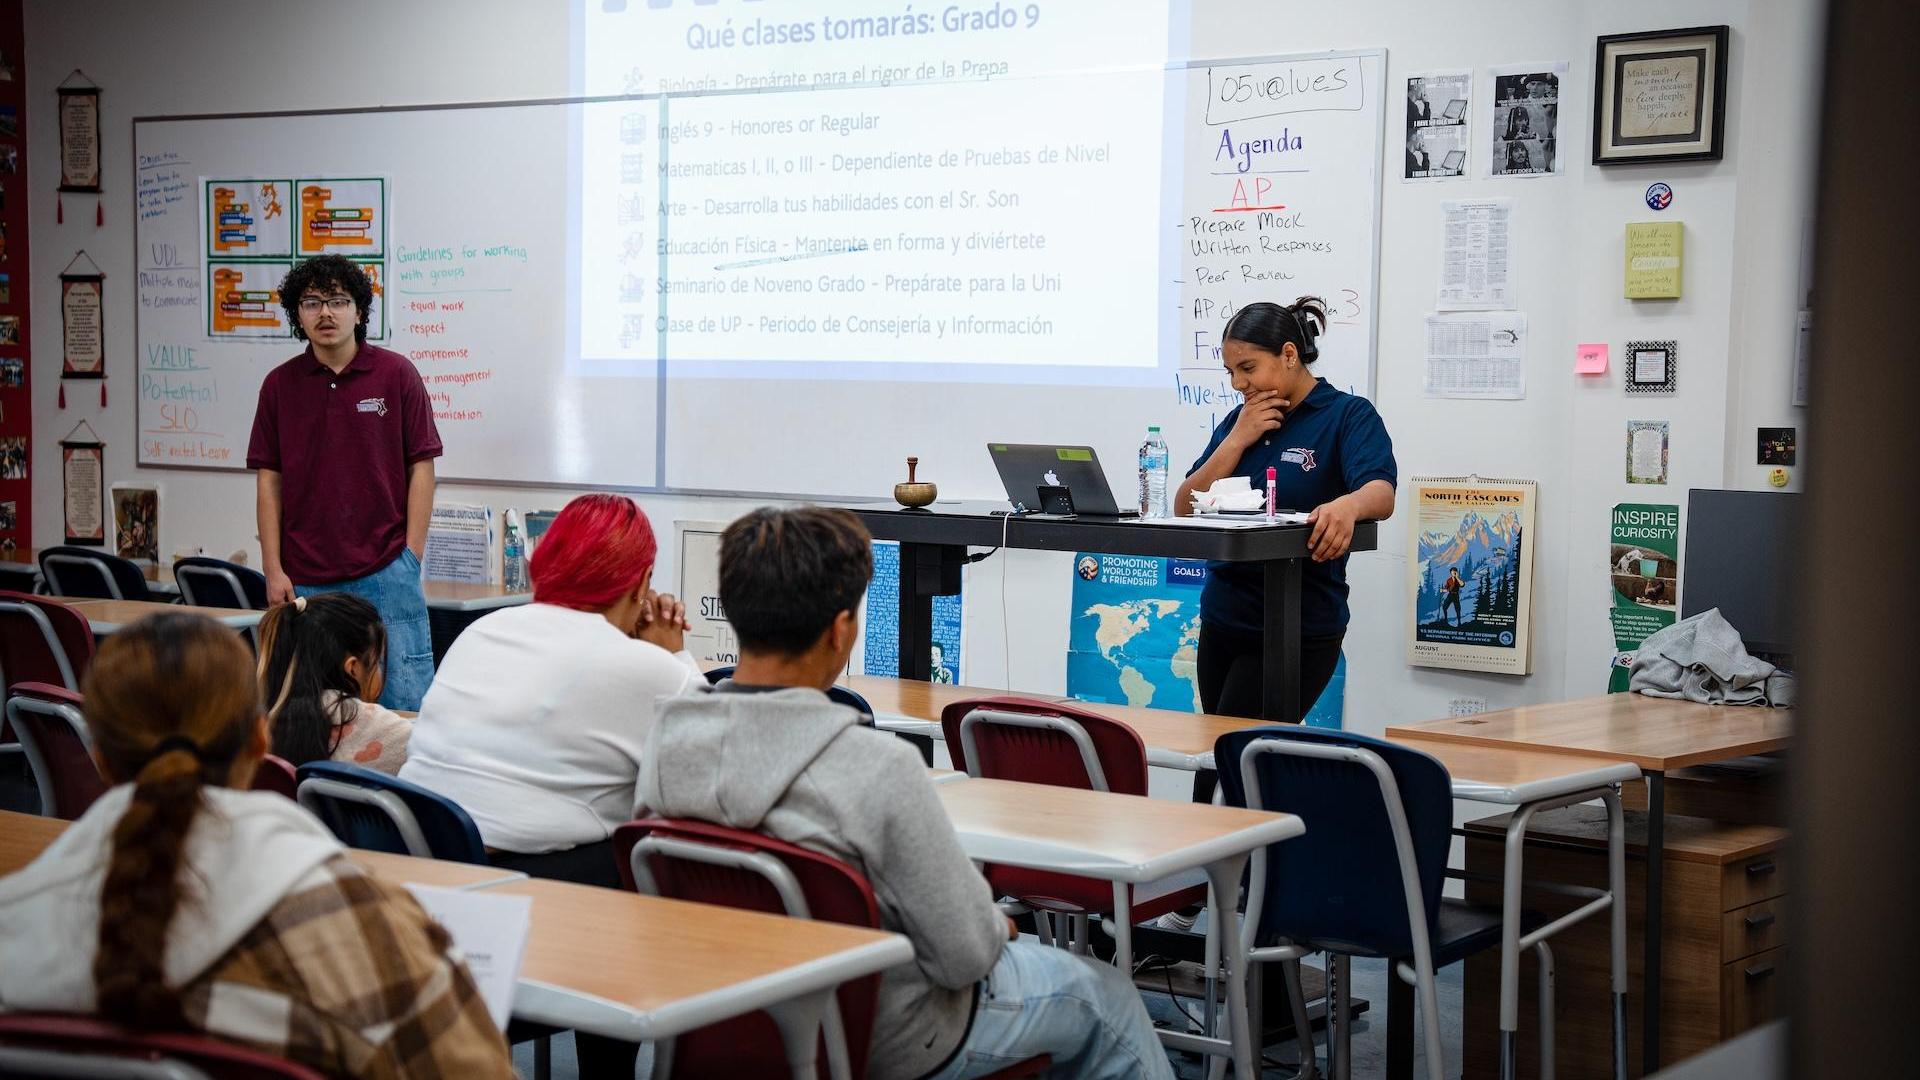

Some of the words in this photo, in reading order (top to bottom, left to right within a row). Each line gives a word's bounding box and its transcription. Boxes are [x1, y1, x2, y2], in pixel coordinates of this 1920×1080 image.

[686, 18, 735, 50] Qué
[742, 16, 815, 47] clases
[823, 4, 935, 42] tomarás:
[942, 2, 1018, 34] Grado
[1024, 4, 1040, 28] 9
[813, 70, 847, 91] para
[852, 65, 866, 82] el
[871, 65, 908, 87] rigor
[915, 60, 936, 79] de
[942, 59, 955, 79] la
[962, 60, 1009, 81] Prepa
[657, 121, 699, 144] Inglés
[703, 121, 713, 137] 9
[731, 119, 793, 136] Honores
[798, 118, 816, 134] or
[820, 112, 881, 137] Regular
[784, 160, 795, 174] o
[831, 150, 933, 176] Dependiente
[938, 149, 958, 167] de
[964, 147, 1031, 167] Pruebas
[1037, 144, 1058, 164] de
[1064, 142, 1111, 162] Nivel
[1215, 127, 1303, 174] Agenda
[657, 199, 687, 216] Arte
[704, 196, 779, 216] Desarrolla
[784, 198, 807, 213] tus
[813, 192, 898, 213] habilidades
[904, 195, 934, 210] con
[939, 189, 953, 209] el
[959, 190, 980, 209] Sr.
[987, 189, 1020, 208] Son
[1231, 177, 1272, 207] AP
[1191, 216, 1247, 237] Prepare
[657, 234, 729, 256] Educación
[735, 234, 777, 254] Física
[795, 235, 869, 253] Mantente
[873, 236, 892, 251] en
[897, 232, 945, 251] forma
[951, 236, 961, 256] y
[965, 229, 1046, 250] diviértete
[1191, 239, 1251, 257] Written
[1259, 235, 1333, 254] Responses
[151, 243, 184, 267] UDL
[396, 246, 453, 263] Guidelines
[463, 245, 477, 258] for
[484, 246, 528, 263] working
[400, 268, 423, 281] with
[431, 267, 465, 286] groups
[656, 276, 727, 295] Seminario
[730, 275, 750, 293] de
[754, 275, 813, 293] Noveno
[817, 273, 866, 293] Grado
[885, 272, 962, 297] Prepárate
[968, 276, 1006, 297] para
[1011, 272, 1026, 291] la
[1031, 272, 1062, 292] Uni
[1195, 266, 1230, 286] Peer
[410, 301, 436, 313] equal
[441, 301, 464, 311] work
[1194, 298, 1215, 320] AP
[409, 322, 446, 338] respect
[656, 315, 695, 333] Clase
[697, 313, 716, 333] de
[720, 315, 742, 333] UP
[759, 314, 817, 333] Periodo
[822, 314, 842, 333] de
[846, 313, 931, 338] Consejería
[937, 320, 946, 339] y
[952, 313, 1054, 335] Información
[148, 344, 199, 368] VALUE
[409, 349, 469, 361] compromise
[434, 370, 491, 387] management
[1425, 493, 1461, 501] NORTH
[1465, 493, 1520, 503] CASCADES
[1614, 511, 1677, 526] INSPIRE
[1614, 527, 1676, 539] CURIOSITY
[1102, 556, 1158, 570] PROMOTING
[1102, 566, 1131, 576] WORLD
[1132, 568, 1158, 578] PEACE
[1173, 567, 1201, 577] GOALS
[1109, 576, 1158, 586] FRIENDSHIP
[700, 596, 725, 618] STR
[715, 626, 734, 649] TH
